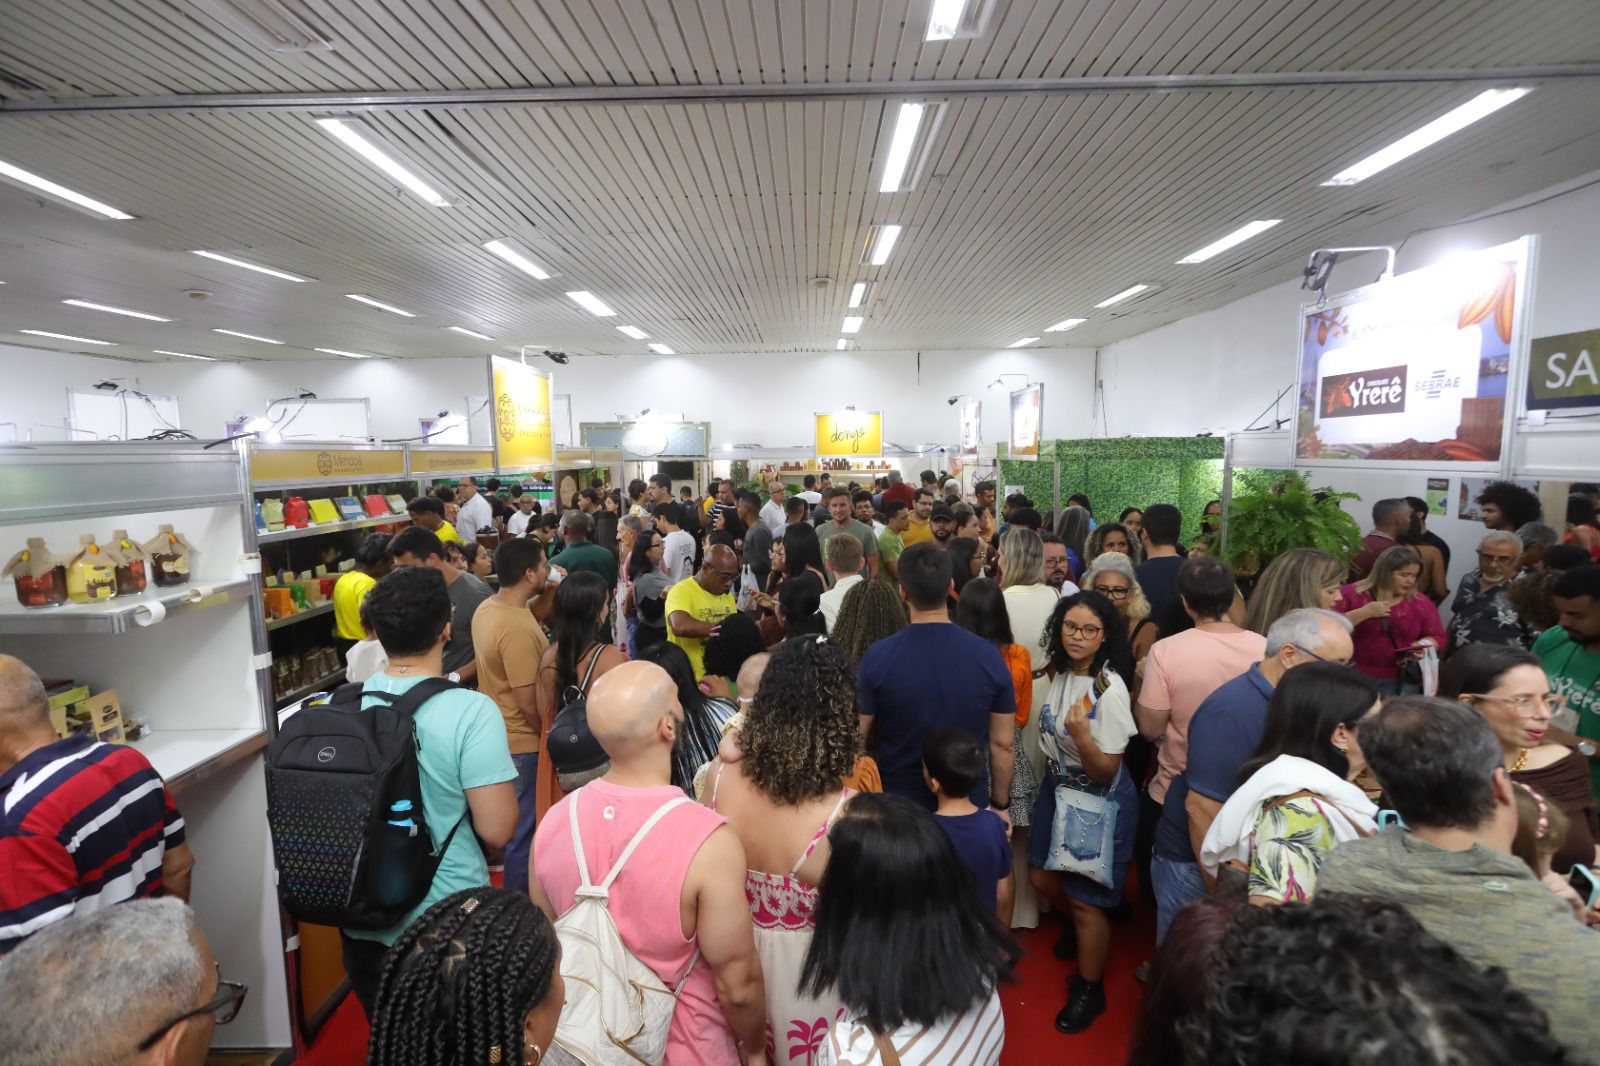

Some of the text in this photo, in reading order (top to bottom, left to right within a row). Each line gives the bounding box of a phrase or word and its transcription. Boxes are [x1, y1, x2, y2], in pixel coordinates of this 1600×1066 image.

[1349, 376, 1402, 408] Yrerê
[1414, 377, 1461, 391] SEBRAE
[830, 421, 865, 454] dengo
